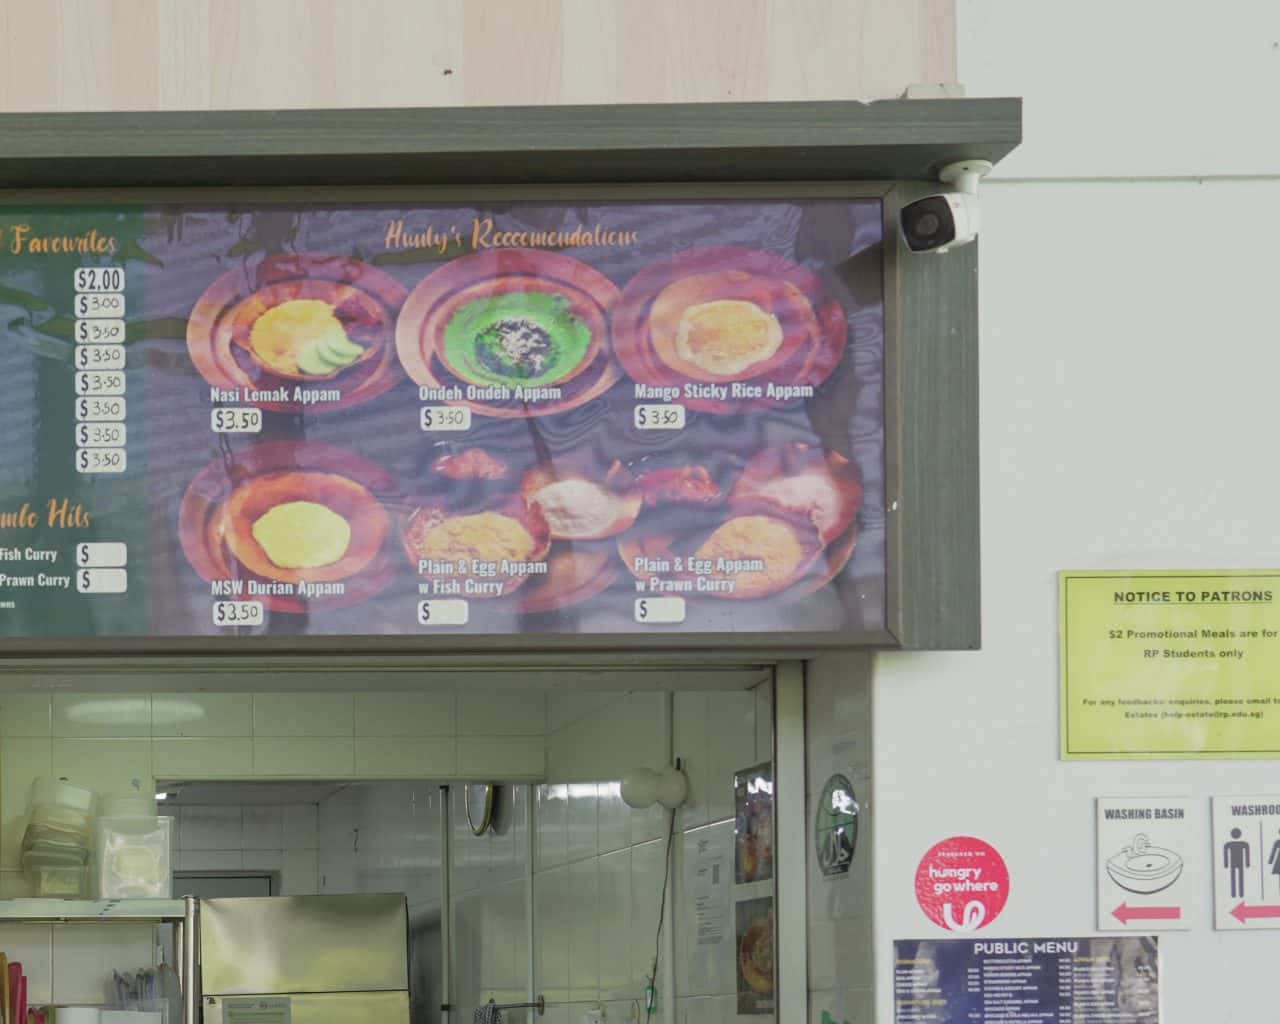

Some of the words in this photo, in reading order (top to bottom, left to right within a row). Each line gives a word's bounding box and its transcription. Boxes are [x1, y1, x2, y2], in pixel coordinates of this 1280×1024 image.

[10, 224, 117, 255] Favourites
[78, 270, 120, 290] $2.00
[211, 388, 240, 401] Nasi
[244, 387, 289, 402] Lemak
[293, 387, 340, 404] Appam
[46, 499, 92, 528] Hits
[38, 573, 70, 589] Curry
[211, 581, 243, 595] MSW
[248, 580, 293, 595] Durian
[297, 580, 345, 598] Appam
[1114, 592, 1170, 602] NOTICE
[1176, 592, 1196, 602] TO
[1201, 591, 1273, 602] PATRONS
[1127, 630, 1197, 639] Promotional
[1202, 630, 1236, 638] Meals
[1262, 629, 1278, 638] for
[1144, 650, 1159, 658] RP
[1162, 649, 1216, 658] Students
[1219, 649, 1244, 659] only
[1104, 809, 1152, 819] WASHING
[1154, 808, 1185, 819] BASIN
[928, 865, 981, 881] hungry
[974, 942, 1029, 955] PUBLIC
[1033, 941, 1078, 953] MENU
